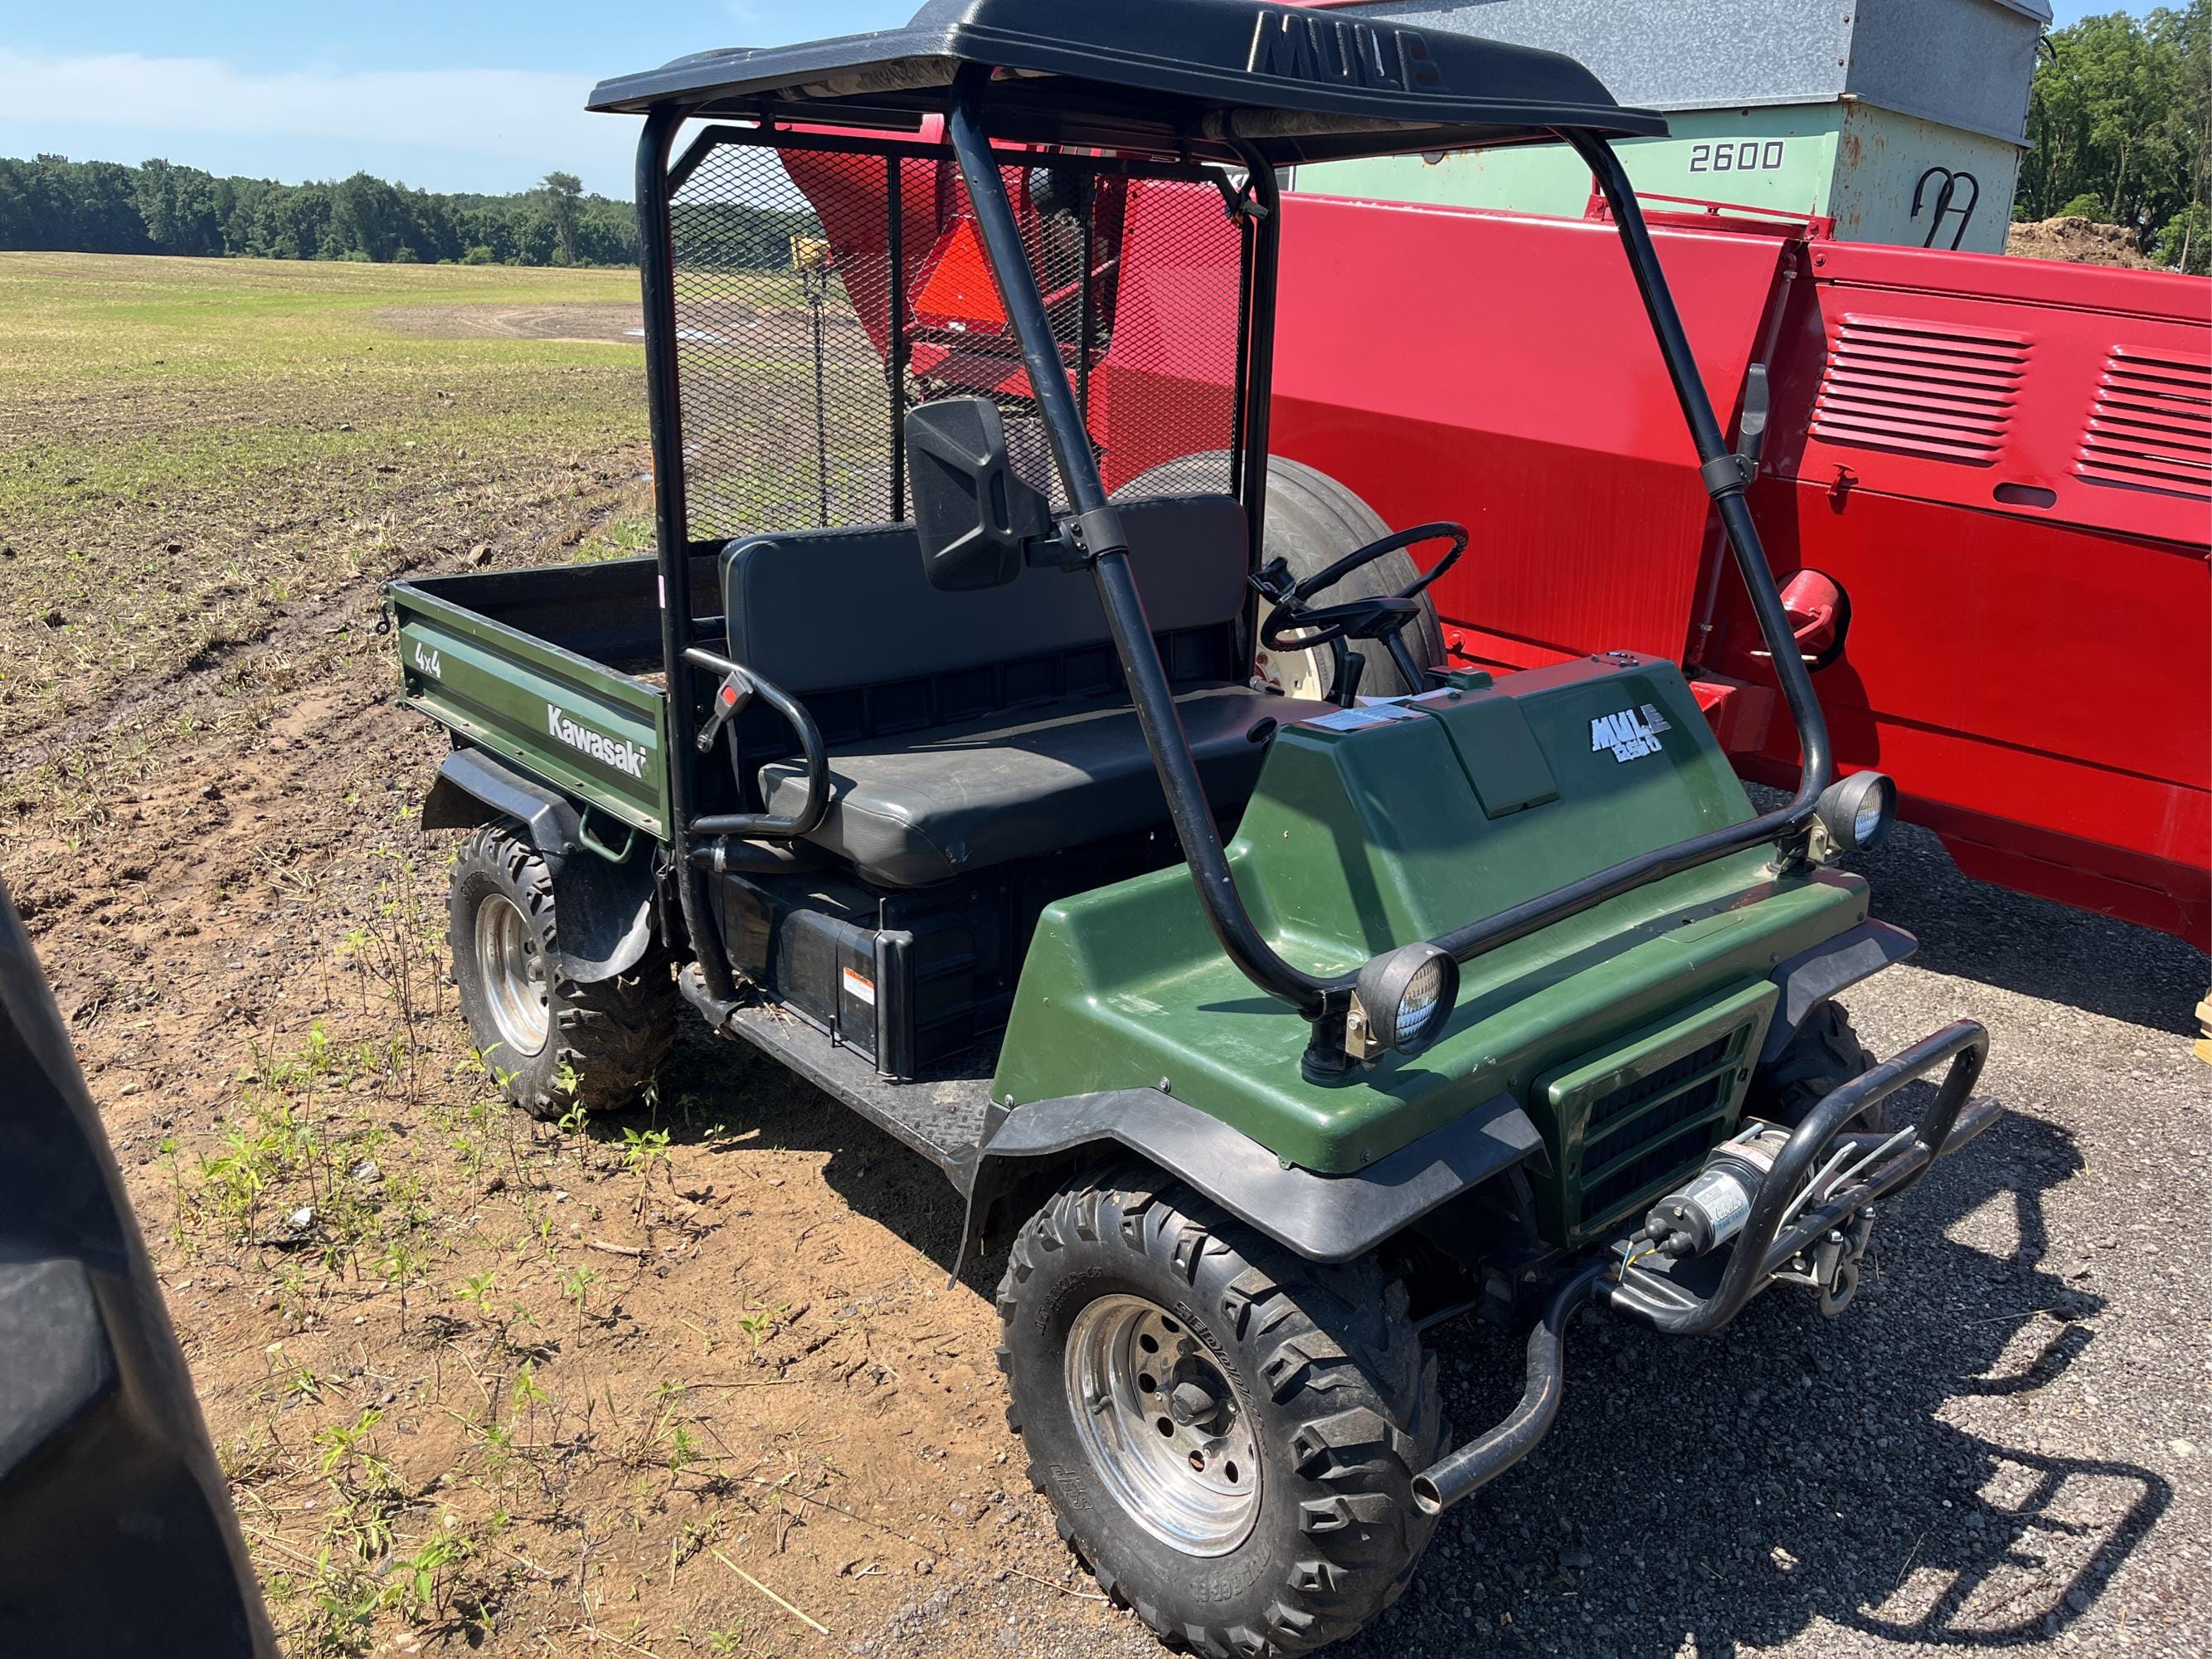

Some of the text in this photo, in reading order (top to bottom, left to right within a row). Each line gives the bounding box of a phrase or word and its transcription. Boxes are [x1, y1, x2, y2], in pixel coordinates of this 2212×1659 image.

[1247, 10, 1450, 93] MULE
[1689, 140, 1785, 173] 2600
[415, 641, 441, 679] 4x4
[547, 703, 647, 779] Kawasaki
[1591, 703, 1672, 752] MULE
